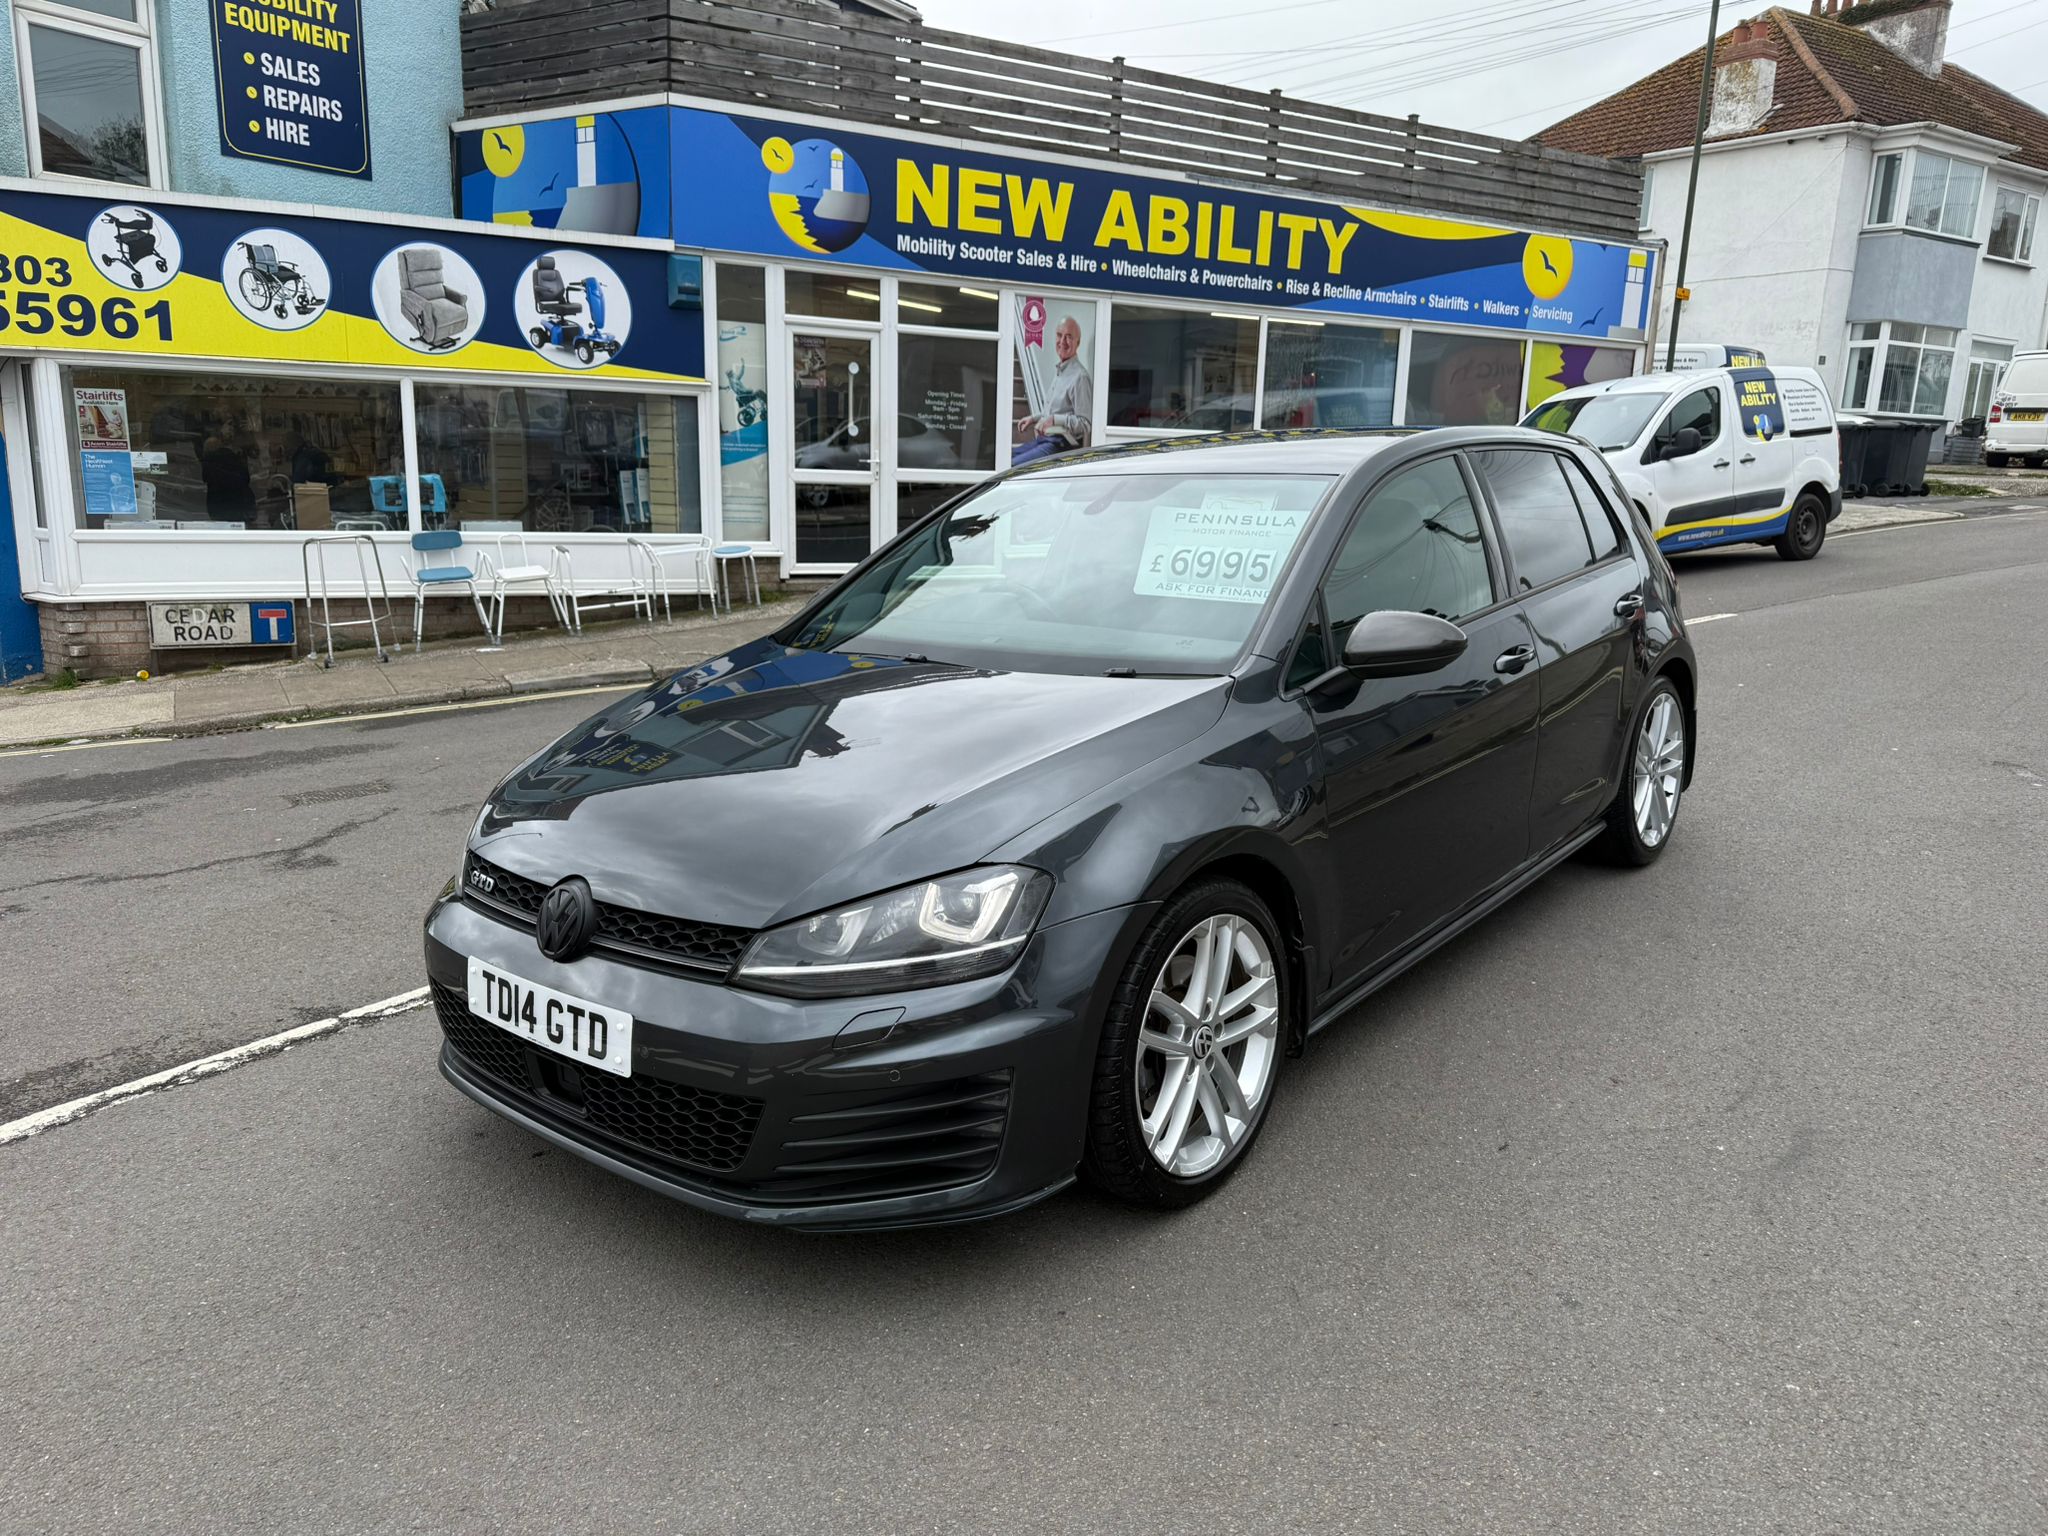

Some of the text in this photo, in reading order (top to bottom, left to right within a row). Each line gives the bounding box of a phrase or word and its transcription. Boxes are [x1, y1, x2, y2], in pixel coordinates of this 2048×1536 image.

[250, 0, 337, 23] ILITY
[225, 2, 350, 54] EQUIPMENT
[260, 53, 321, 86] SALES
[263, 85, 343, 122] REPAIRS
[265, 117, 310, 146] HIRE
[896, 158, 1359, 274] NEW ABILITY
[897, 234, 1573, 323] Mobility Scooter Sales & Hire Wheelchairs & Powerchairs Rise & Recline Armchairs Stairlifts Walkers Servicing
[0, 290, 173, 342] 5961
[76, 390, 124, 401] Stairlifts
[927, 390, 949, 398] Opening
[1743, 381, 1766, 393] NEW
[950, 400, 967, 408] Friday
[1741, 392, 1776, 407] ABILITY
[925, 422, 946, 430] Sunday
[1175, 512, 1296, 528] PENINSULA
[1193, 528, 1272, 538] MOTOR FINANCE
[1149, 549, 1271, 583] £ 6995
[1155, 582, 1182, 591] ASK
[1187, 584, 1216, 594] FOR
[165, 608, 236, 624] CEDAR
[174, 625, 233, 641] ROAD
[470, 870, 495, 893] GTD
[482, 969, 608, 1060] TD14 GTD
